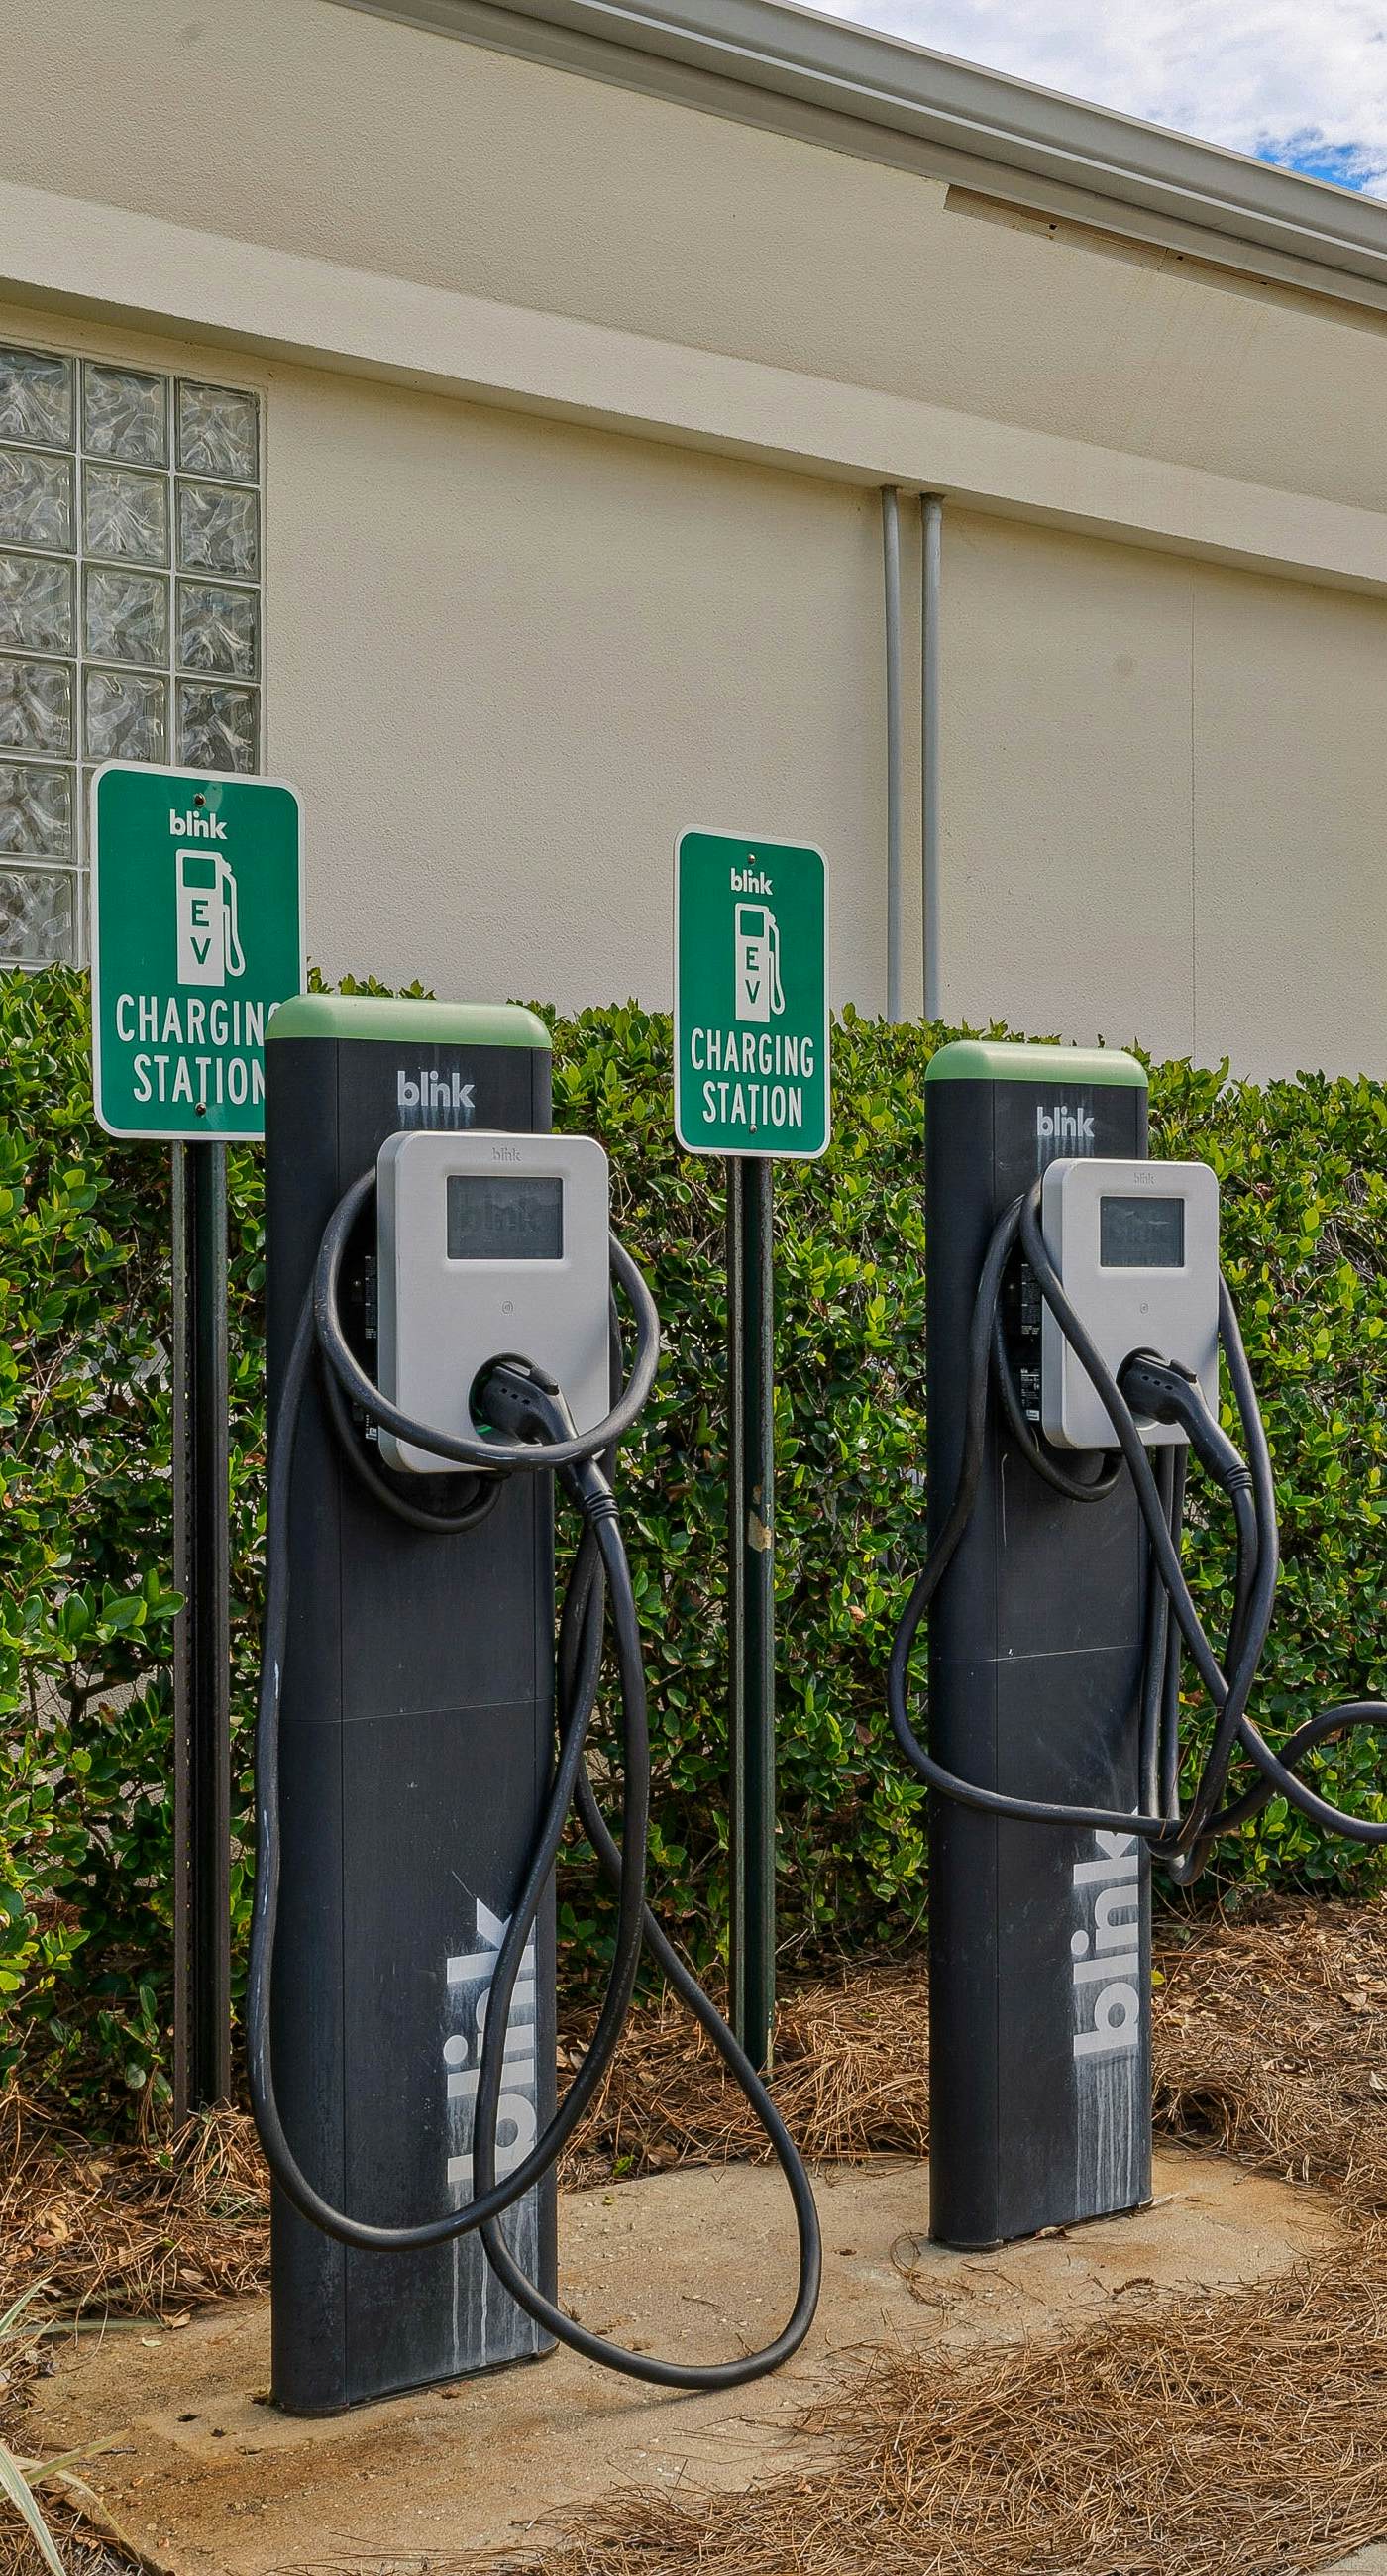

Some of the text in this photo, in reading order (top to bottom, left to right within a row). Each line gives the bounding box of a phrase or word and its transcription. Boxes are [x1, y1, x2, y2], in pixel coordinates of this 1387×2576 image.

[169, 808, 228, 840] blink
[730, 867, 773, 896] blink
[116, 993, 282, 1047] CHARGIN
[691, 1027, 814, 1078] CHARGING
[133, 1053, 266, 1105] STATION
[397, 1070, 476, 1108] blink
[702, 1080, 802, 1127] STATION
[1036, 1105, 1095, 1138] blink
[490, 1146, 523, 1162] blink
[1070, 1805, 1139, 2057] blink
